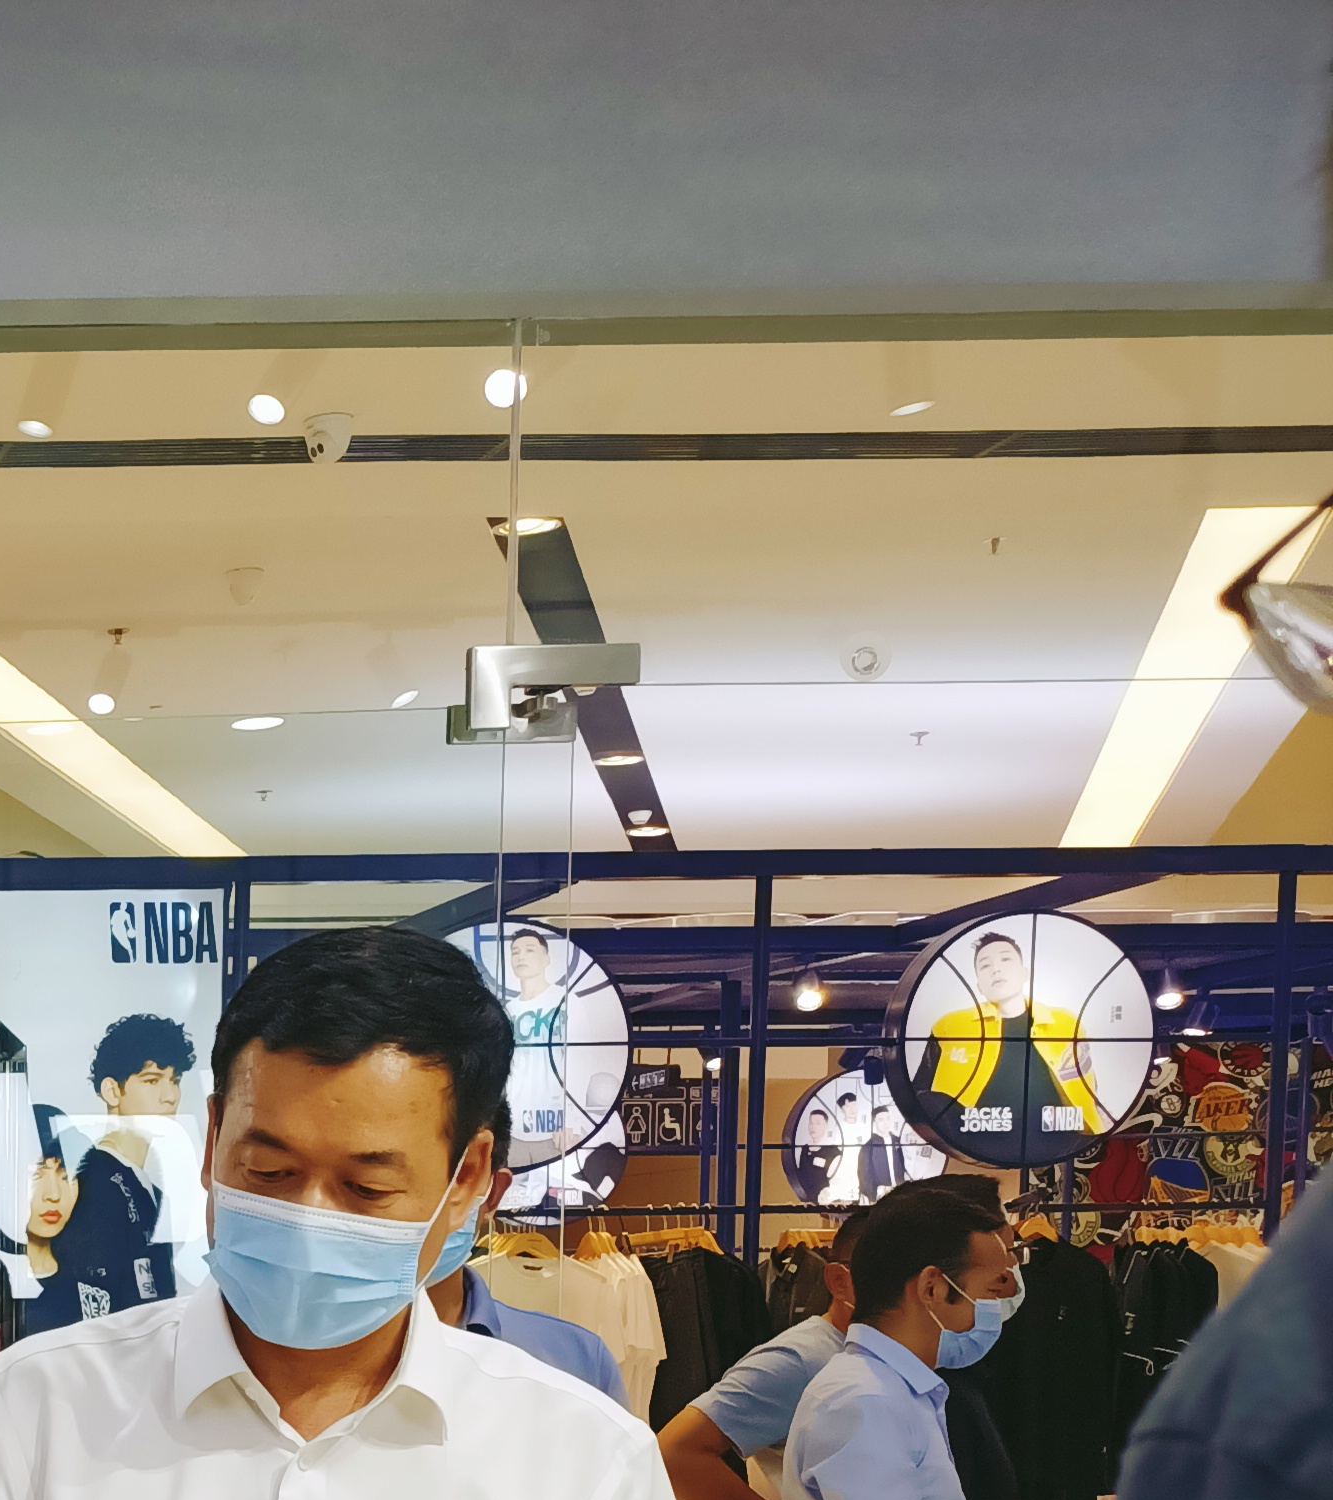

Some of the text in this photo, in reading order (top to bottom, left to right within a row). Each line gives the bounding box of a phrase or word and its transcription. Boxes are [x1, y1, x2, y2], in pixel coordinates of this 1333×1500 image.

[144, 901, 219, 964] NBA
[536, 1109, 564, 1133] NBA
[960, 1106, 1013, 1120] JACK&
[1055, 1106, 1084, 1132] NBA
[960, 1119, 1013, 1132] JONES
